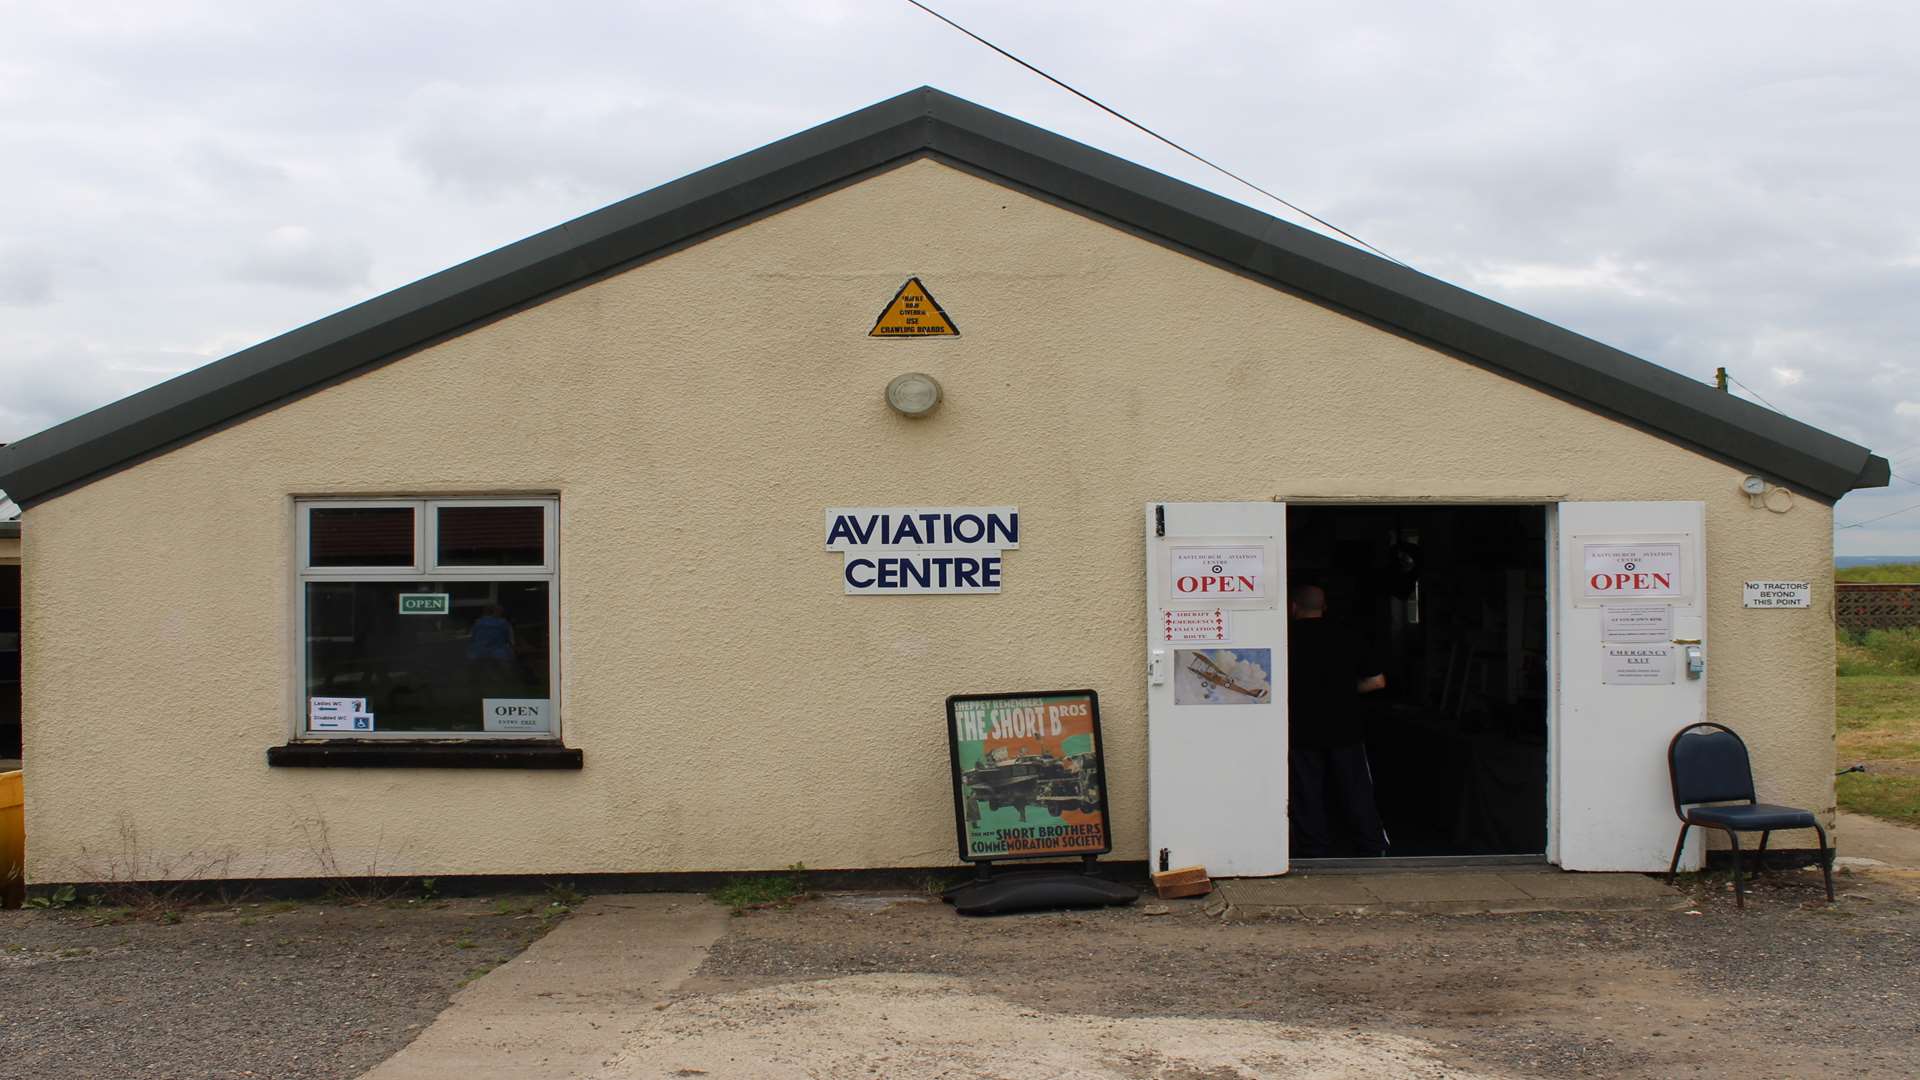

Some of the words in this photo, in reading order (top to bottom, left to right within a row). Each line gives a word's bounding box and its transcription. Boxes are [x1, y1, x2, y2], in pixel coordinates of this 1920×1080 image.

[826, 513, 1018, 545] AVIATION
[845, 557, 1001, 588] CENTRE
[1590, 573, 1670, 590] OPEN
[1176, 575, 1256, 593] OPEN
[406, 599, 442, 608] OPEN
[495, 705, 538, 716] OPEN
[955, 710, 988, 741] THE
[990, 705, 1045, 739] SHORT
[1049, 704, 1088, 736] BROS
[996, 826, 1035, 840] SHORT
[1039, 823, 1101, 837] BROTHERS
[971, 838, 1059, 853] COMMEMORATION
[1062, 835, 1103, 848] SOCIETY
